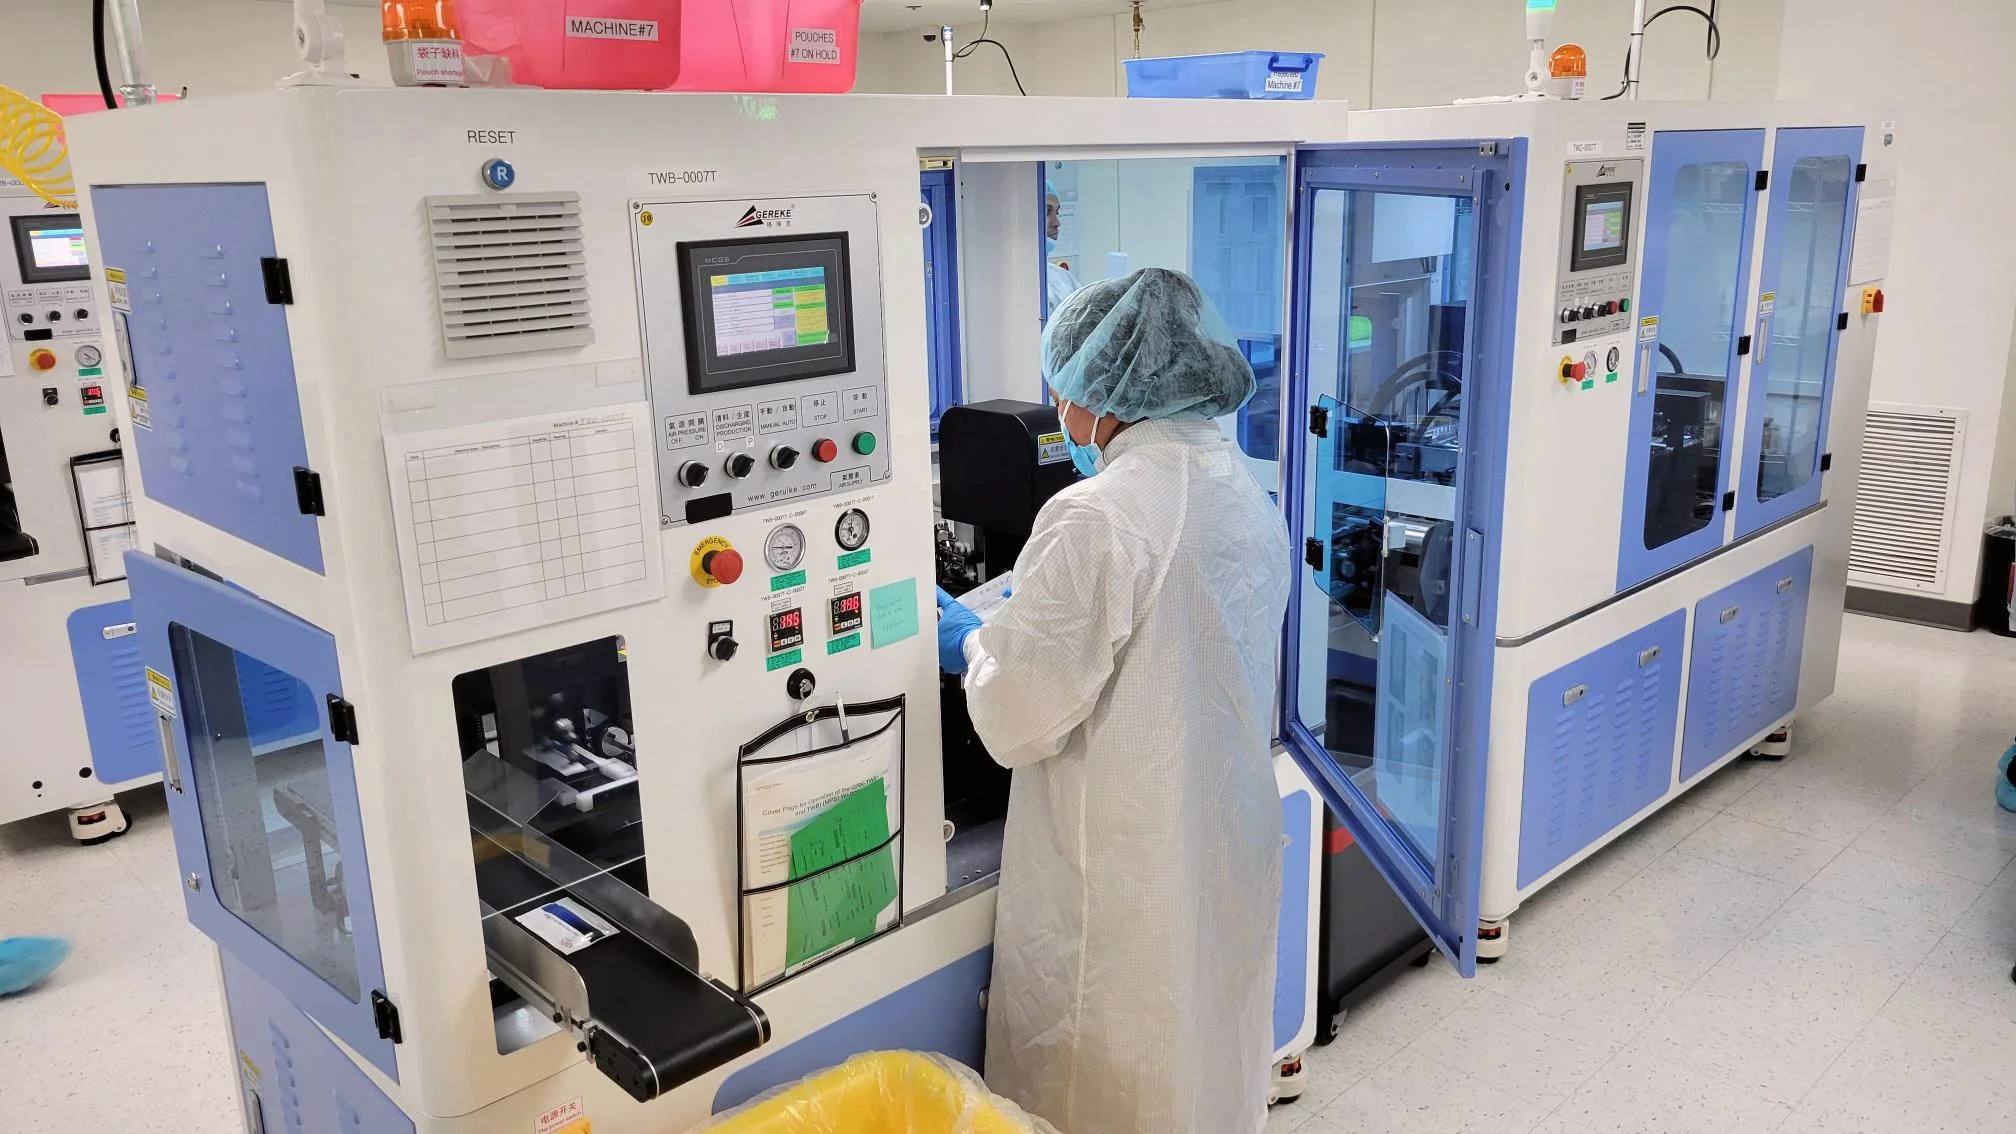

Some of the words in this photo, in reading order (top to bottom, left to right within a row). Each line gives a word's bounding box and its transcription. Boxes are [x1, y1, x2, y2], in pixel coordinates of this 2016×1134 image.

[571, 20, 654, 37] MACHINE#7
[795, 31, 834, 43] POUCHES
[790, 48, 800, 59] #7
[802, 49, 814, 59] ON
[815, 49, 837, 60] HOLD
[416, 68, 439, 76] Pouch
[1268, 80, 1292, 89] Machine
[467, 130, 516, 144] RESET
[497, 166, 508, 181] R
[648, 170, 717, 185] TWB-0007T
[756, 209, 792, 219] GEREKE
[853, 407, 868, 415] START
[813, 413, 828, 421] STOP
[715, 419, 751, 430] DISCHARGING
[760, 420, 781, 430] MANUAL
[783, 419, 796, 427] AUTO
[677, 427, 707, 437] PRESSURE
[716, 427, 752, 437] PRODUCTION
[802, 483, 817, 491] com
[694, 537, 730, 556] EMERGENCY
[782, 804, 798, 813] Page
